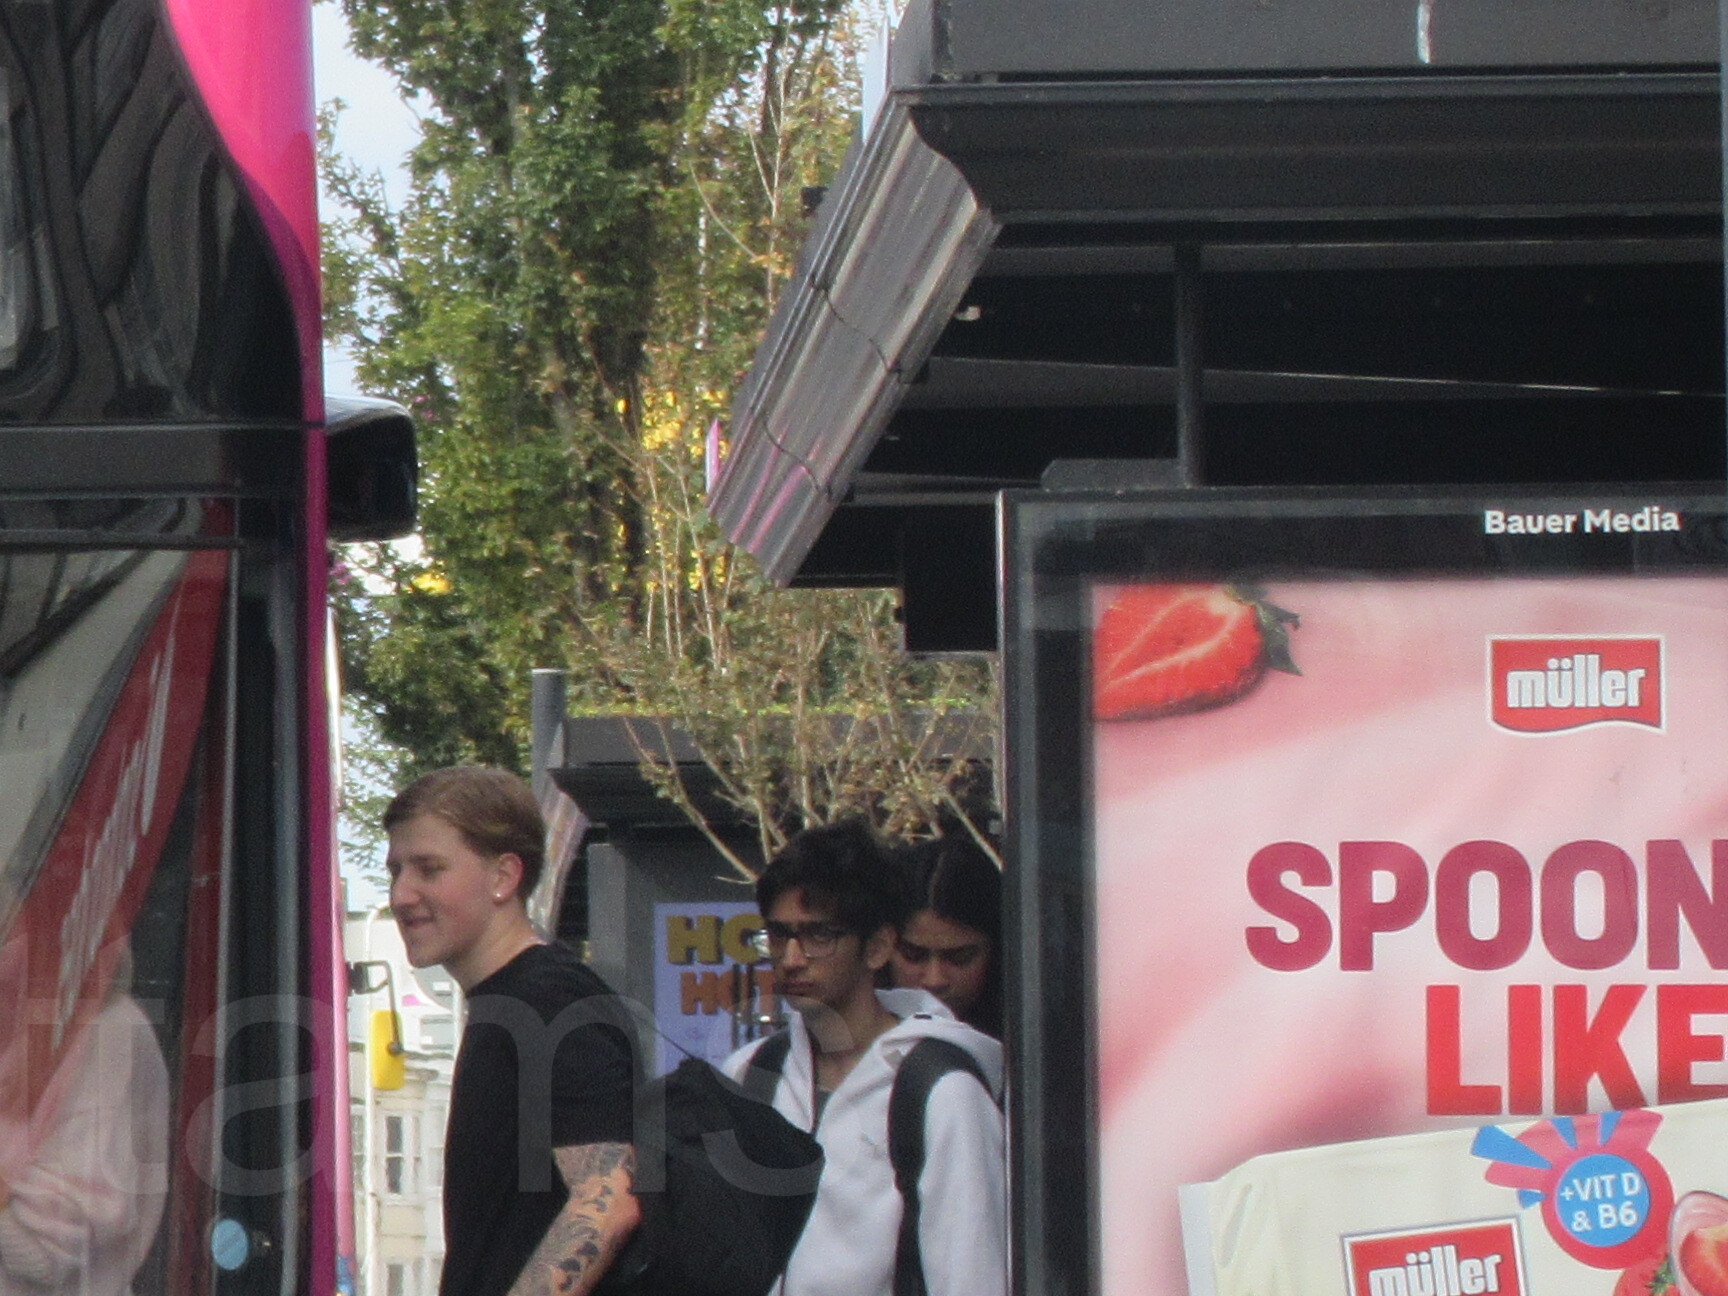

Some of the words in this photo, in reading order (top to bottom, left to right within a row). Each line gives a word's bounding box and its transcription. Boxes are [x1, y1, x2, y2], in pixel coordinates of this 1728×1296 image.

[1484, 508, 1578, 535] Bauer
[1583, 506, 1680, 534] Media
[1505, 654, 1647, 708] müller
[1245, 839, 1728, 972] SPOON
[1425, 984, 1728, 1116] LIKE
[1621, 1172, 1641, 1196] D
[1571, 1208, 1592, 1233] &
[1598, 1201, 1638, 1229] B6
